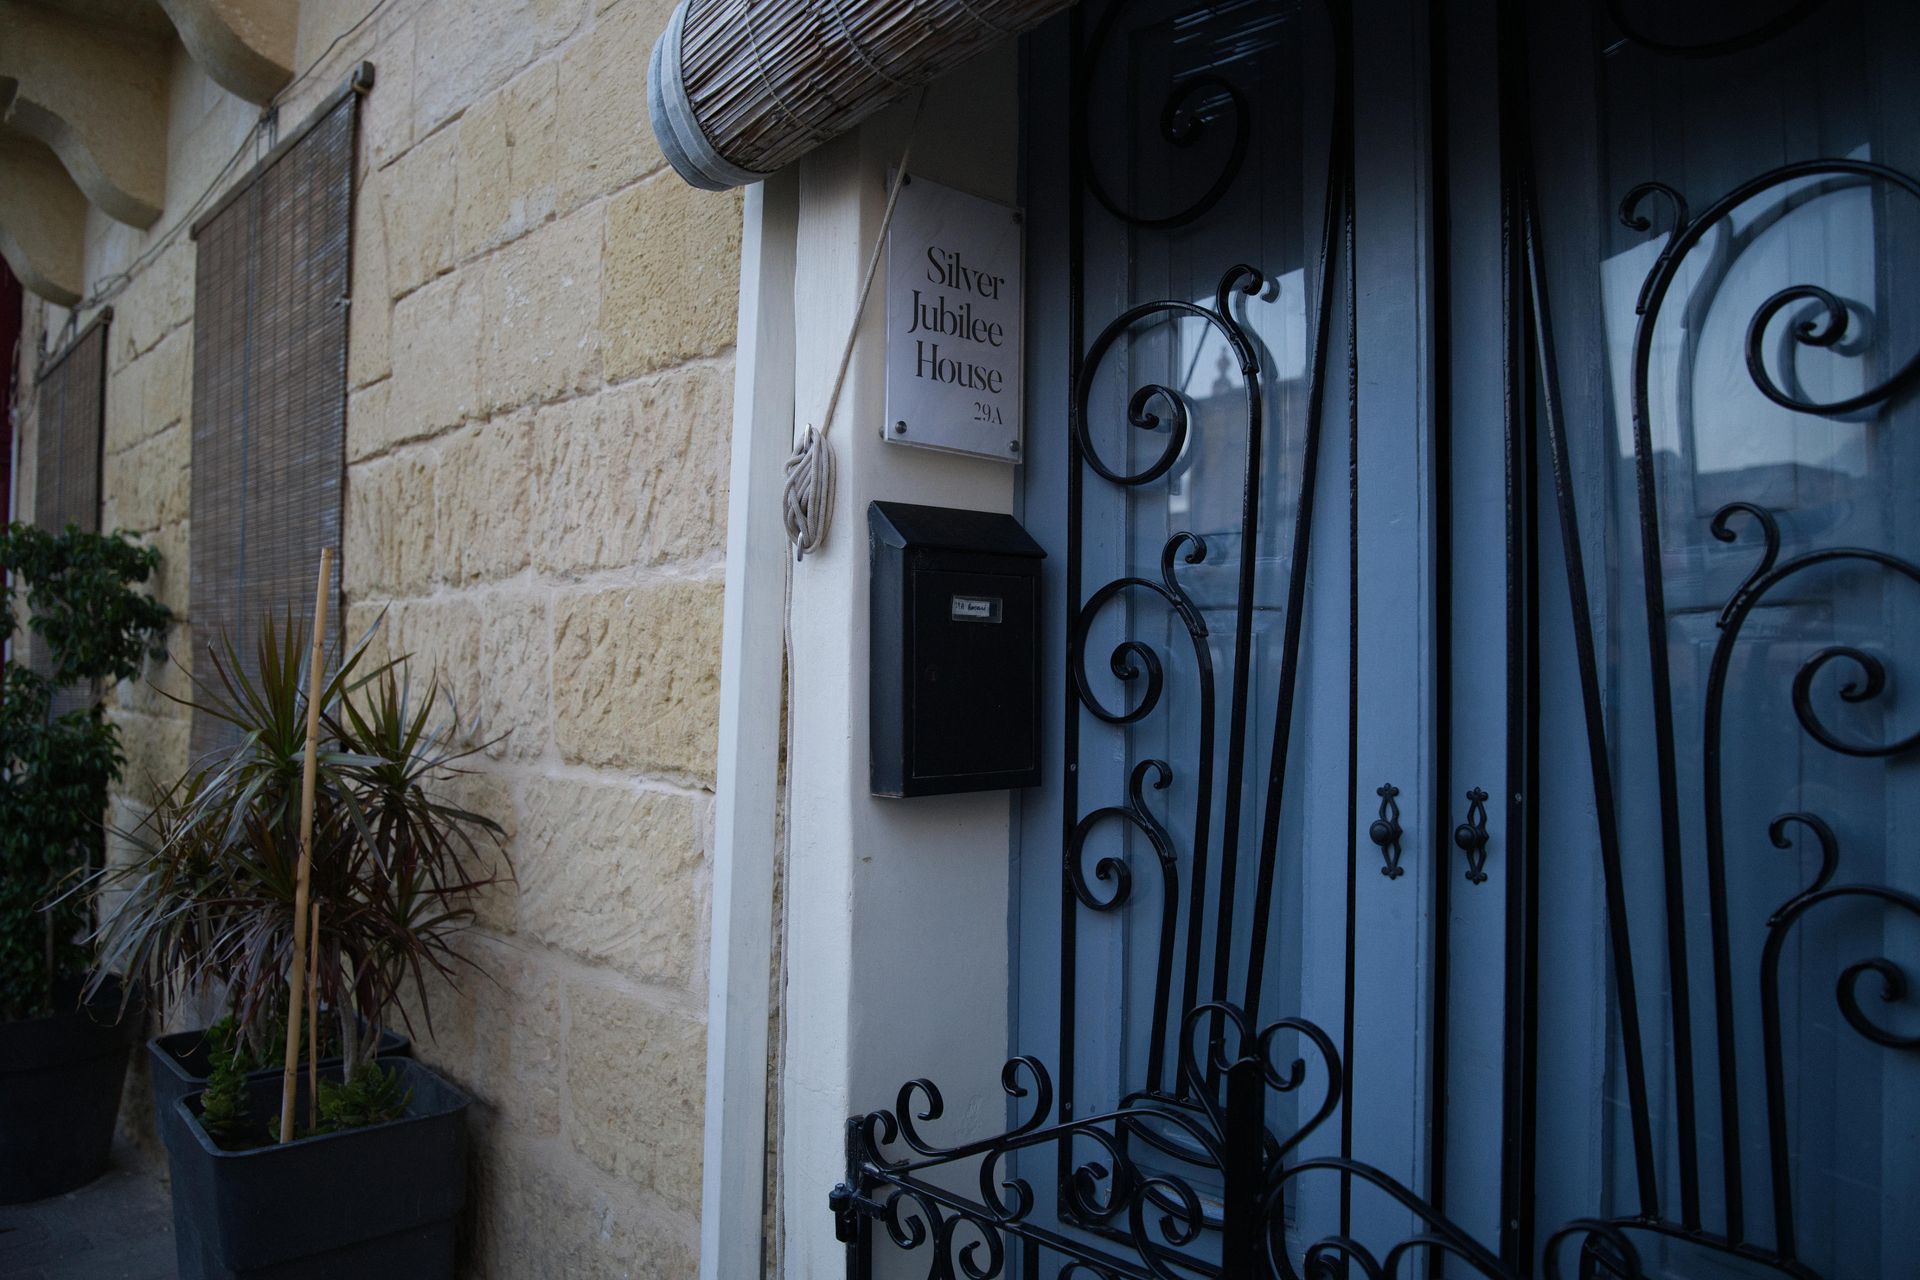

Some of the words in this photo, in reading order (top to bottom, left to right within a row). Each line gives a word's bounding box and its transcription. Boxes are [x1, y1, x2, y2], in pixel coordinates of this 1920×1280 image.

[927, 246, 1005, 300] Silver
[907, 289, 1003, 347] Jubilee
[915, 340, 1003, 394] House
[974, 402, 1003, 425] 29A
